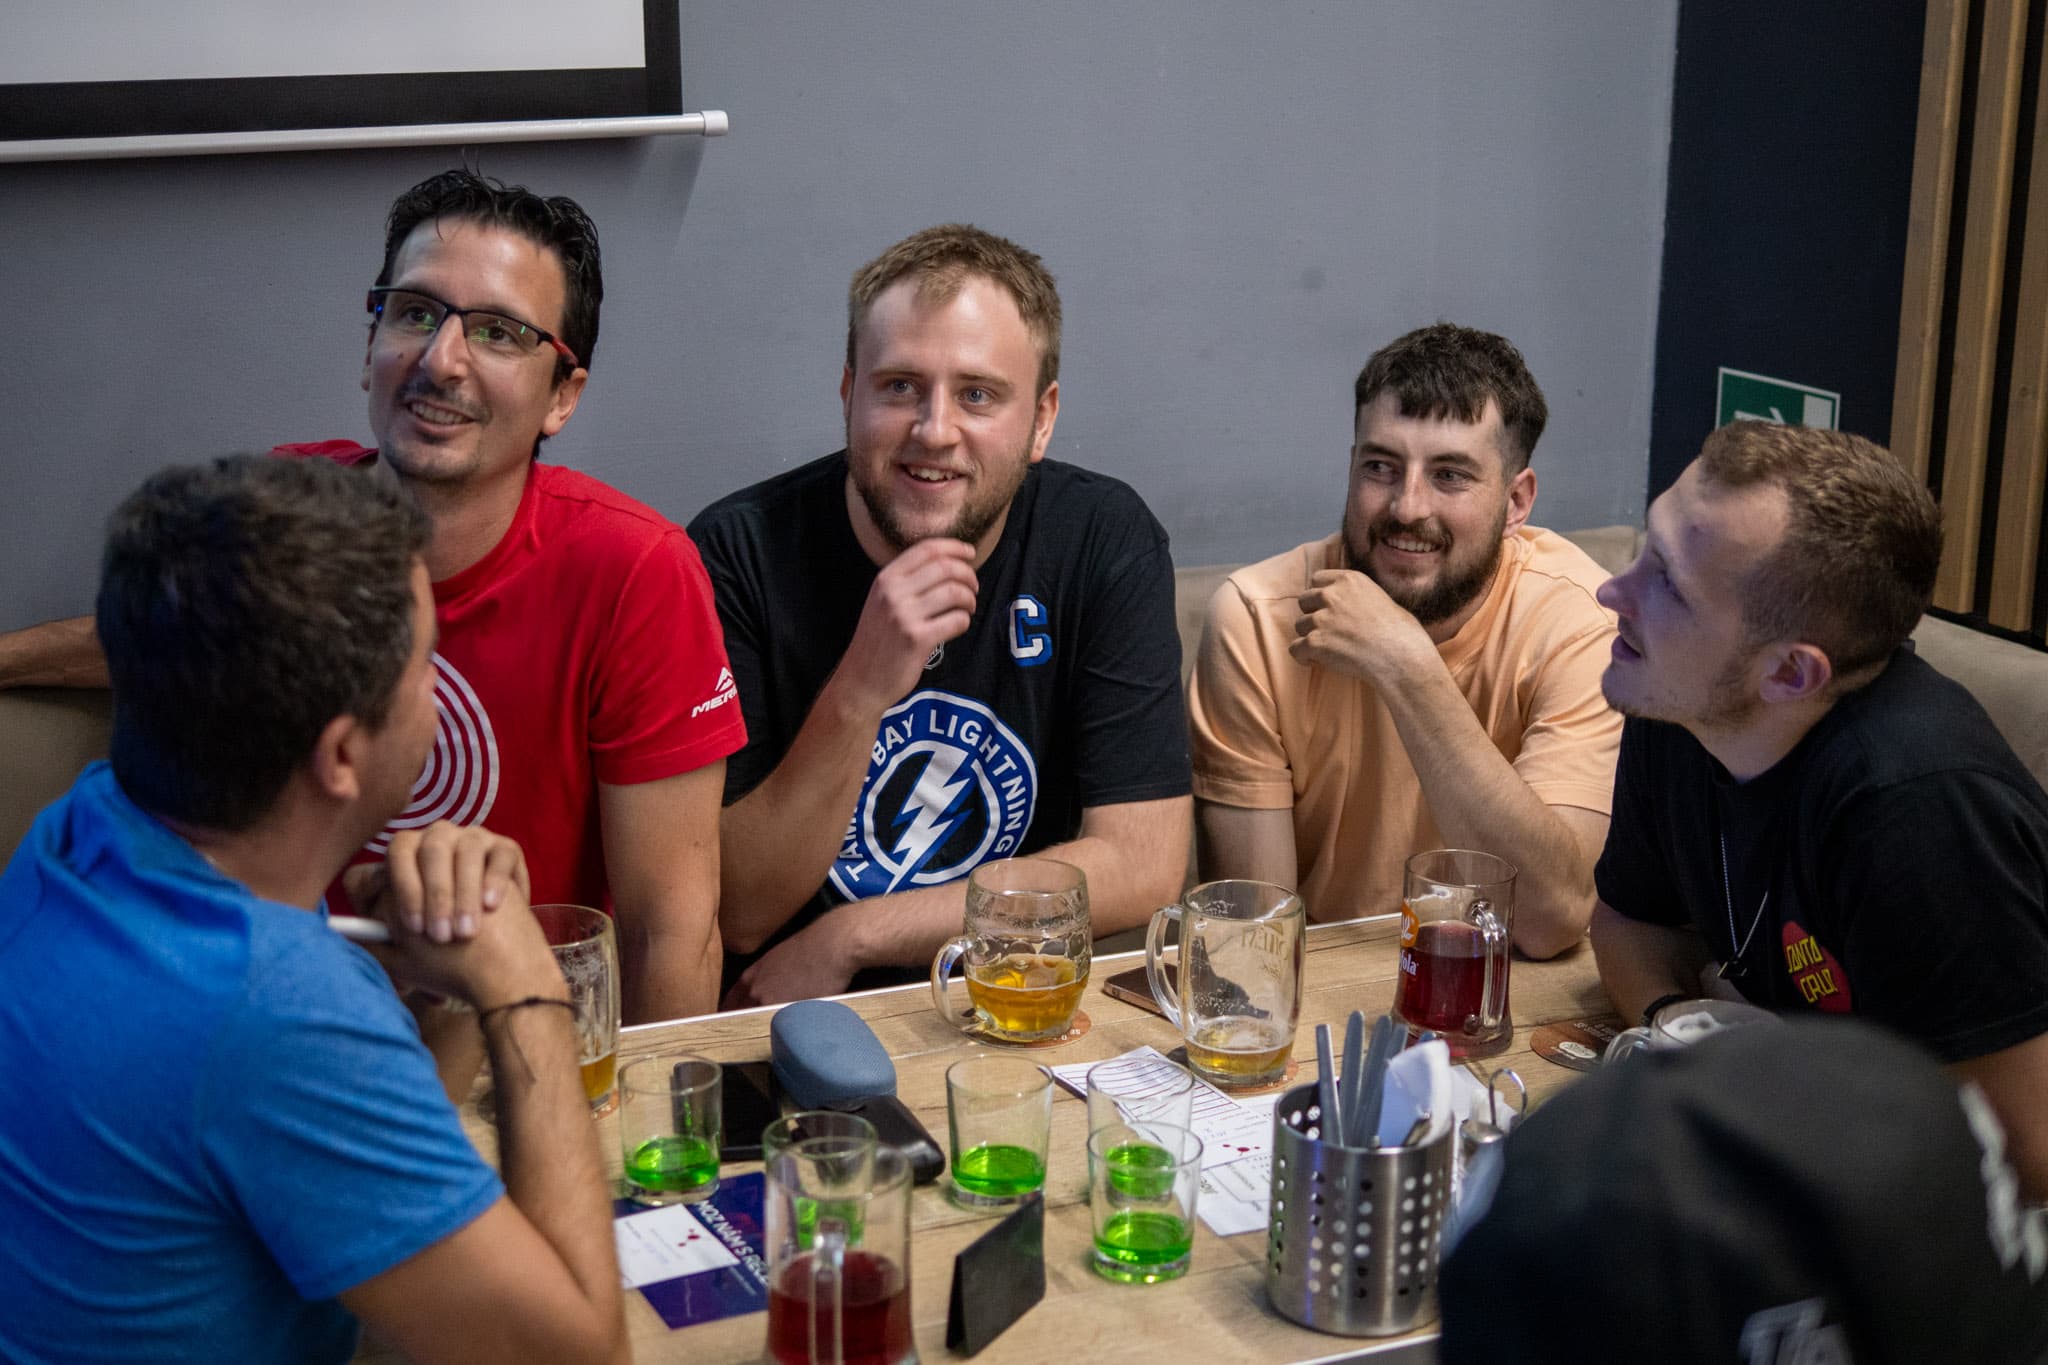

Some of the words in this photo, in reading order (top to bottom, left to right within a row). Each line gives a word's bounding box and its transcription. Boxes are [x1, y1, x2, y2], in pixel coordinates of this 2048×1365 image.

[1010, 597, 1050, 664] C
[872, 713, 914, 767] BAY
[929, 709, 1027, 853] LIGHTNING
